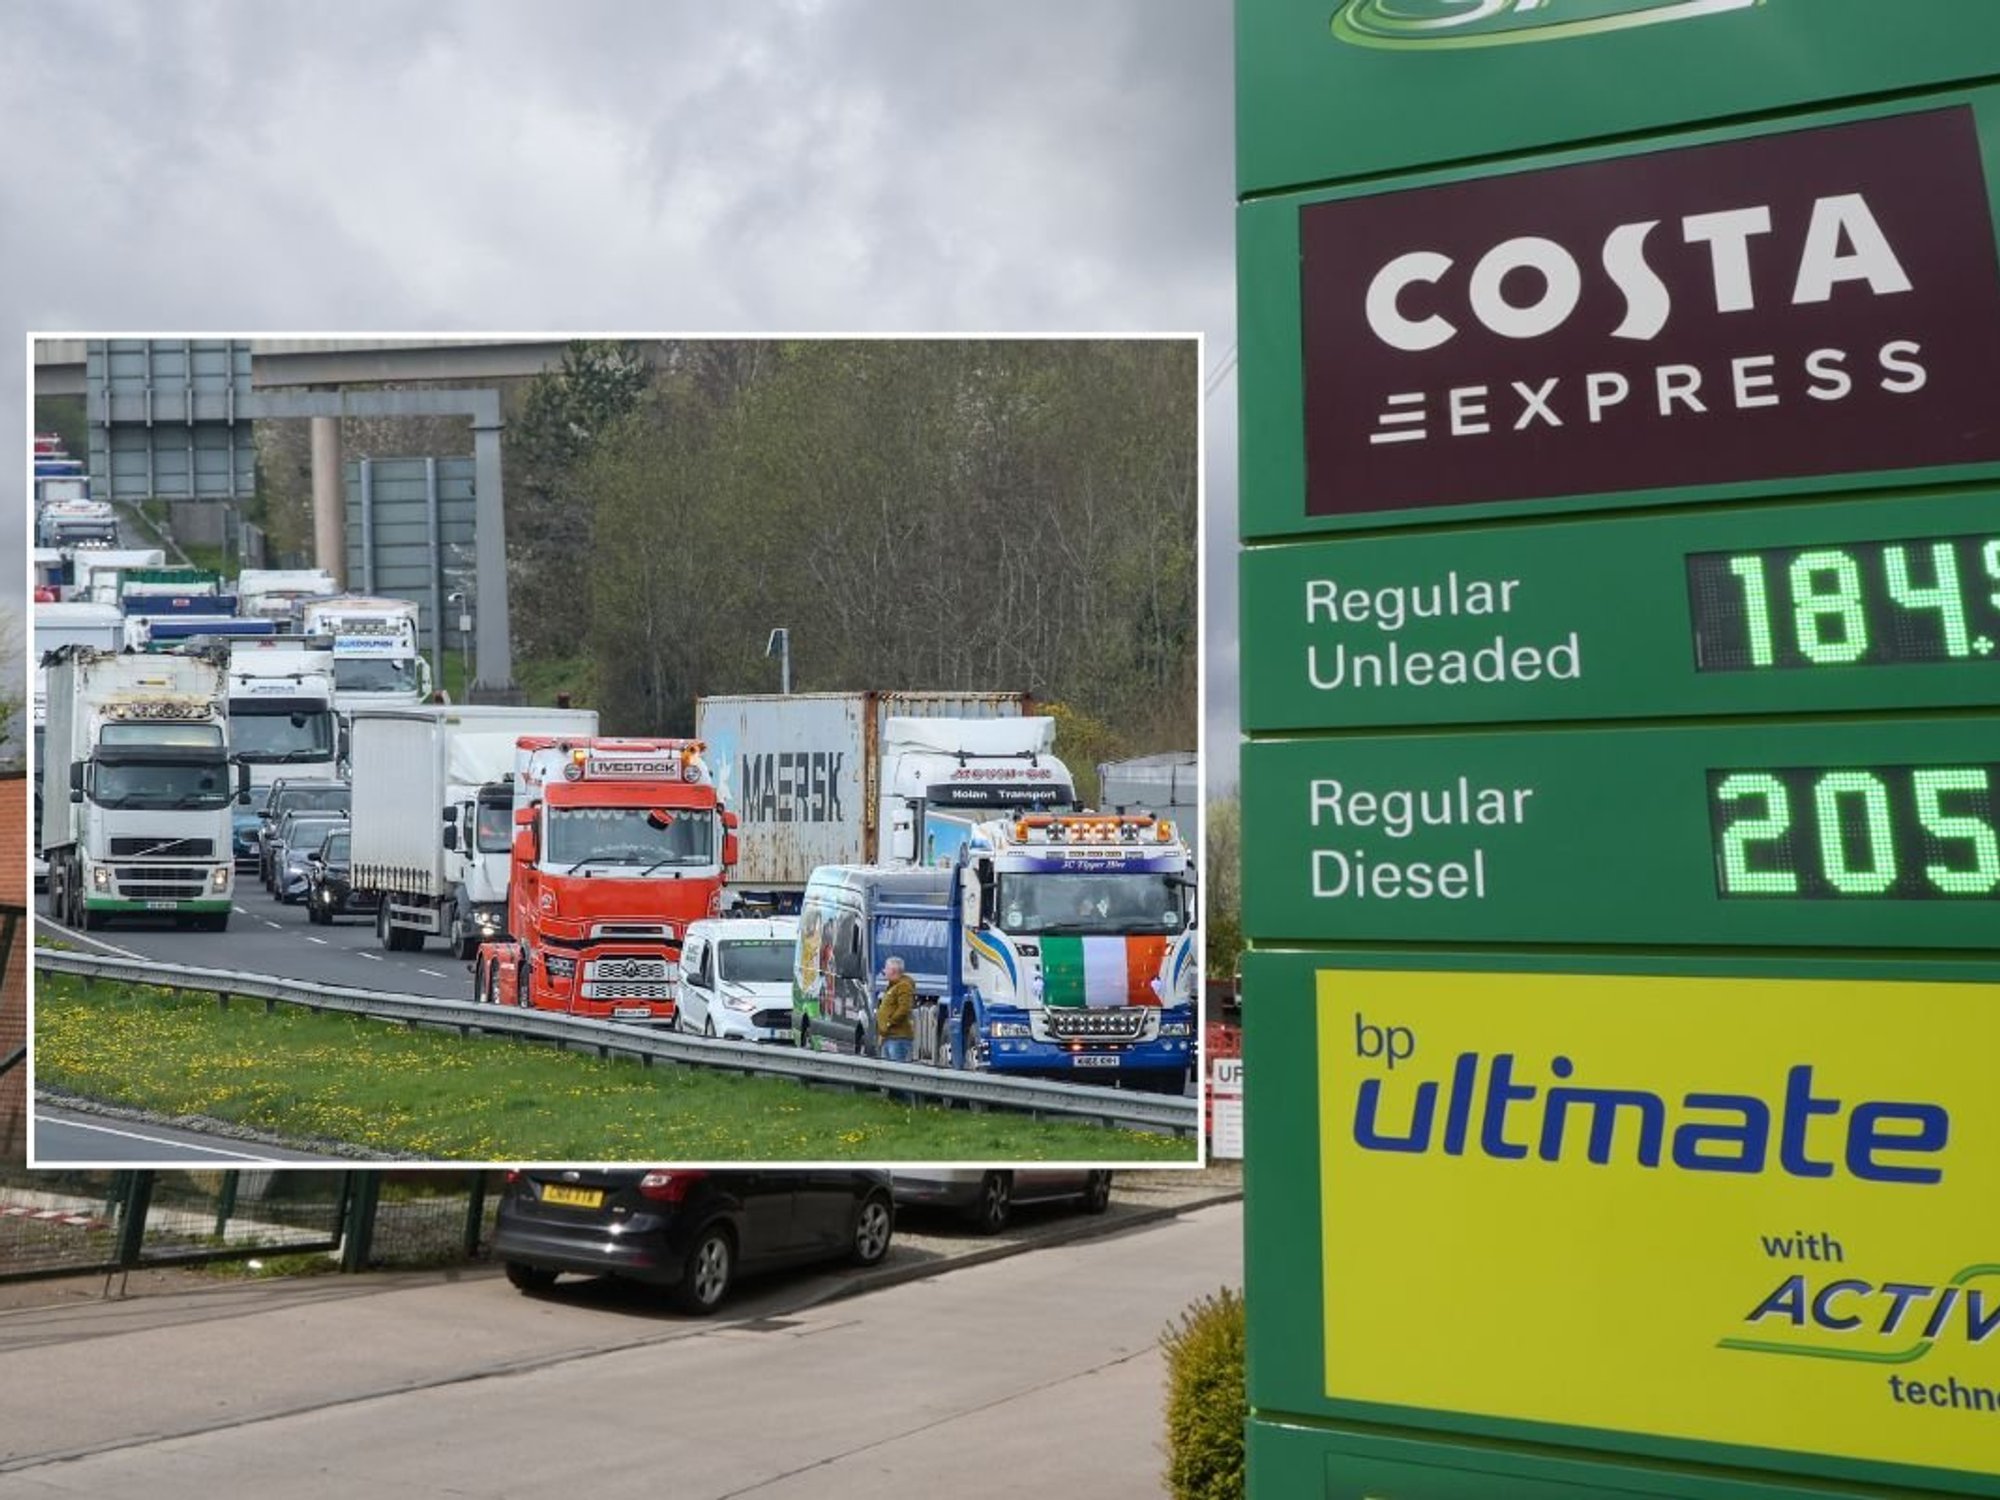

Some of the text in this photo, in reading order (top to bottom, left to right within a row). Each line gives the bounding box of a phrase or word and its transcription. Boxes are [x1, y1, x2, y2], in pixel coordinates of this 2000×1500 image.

[1365, 193, 1913, 351] COSTA
[1449, 341, 1928, 437] EXPRESS
[1306, 571, 1520, 629] Regular
[1307, 632, 1582, 690] Unleaded
[591, 762, 675, 774] LIVESTOCK
[742, 752, 845, 822] MAERSK
[998, 789, 1057, 801] Transport
[1309, 777, 1533, 838] Regular
[1311, 849, 1486, 899] Diesel
[1355, 1013, 1415, 1069] bp
[1353, 1052, 1949, 1185] ultimate
[1762, 1231, 1843, 1262] with
[1888, 1375, 2000, 1411] techn
